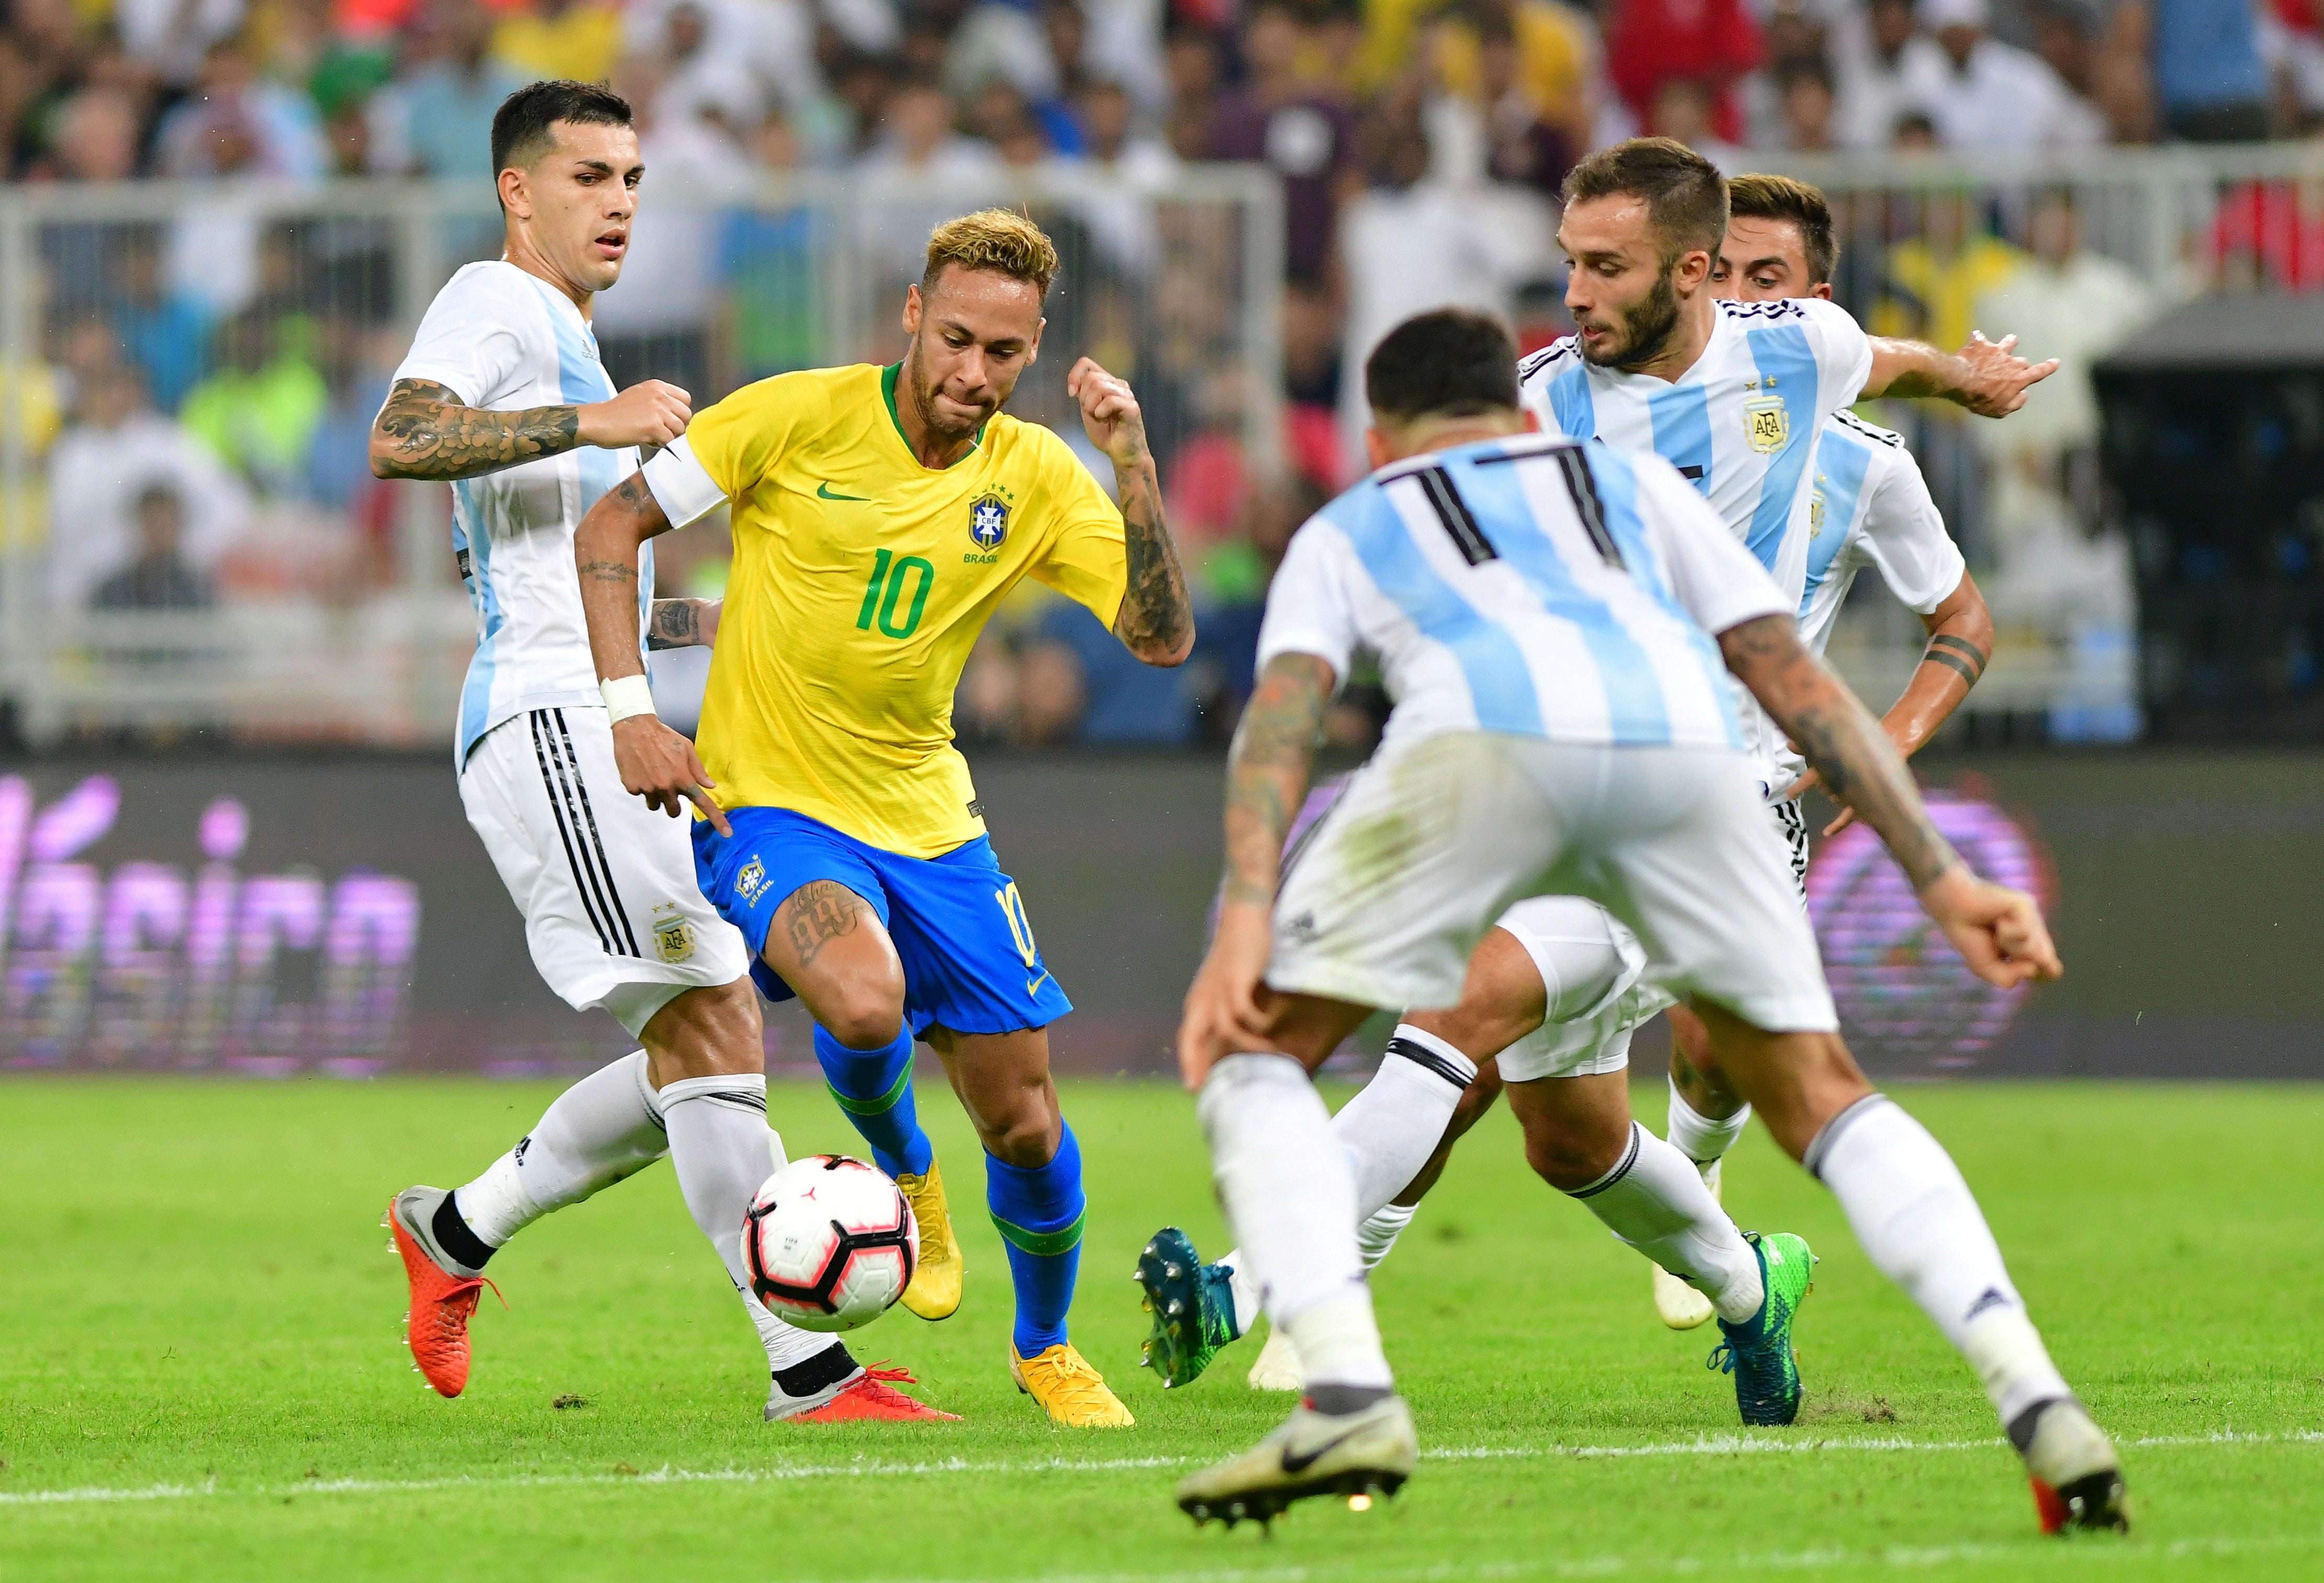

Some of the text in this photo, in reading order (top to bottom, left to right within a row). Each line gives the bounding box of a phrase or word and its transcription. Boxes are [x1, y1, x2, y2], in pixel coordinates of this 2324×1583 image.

[1755, 411, 1780, 438] AFA
[1377, 445, 1628, 573] 17
[963, 553, 998, 564] BRASIL
[856, 548, 934, 640] 10
[664, 928, 687, 949] AFA
[994, 881, 1036, 967] 10
